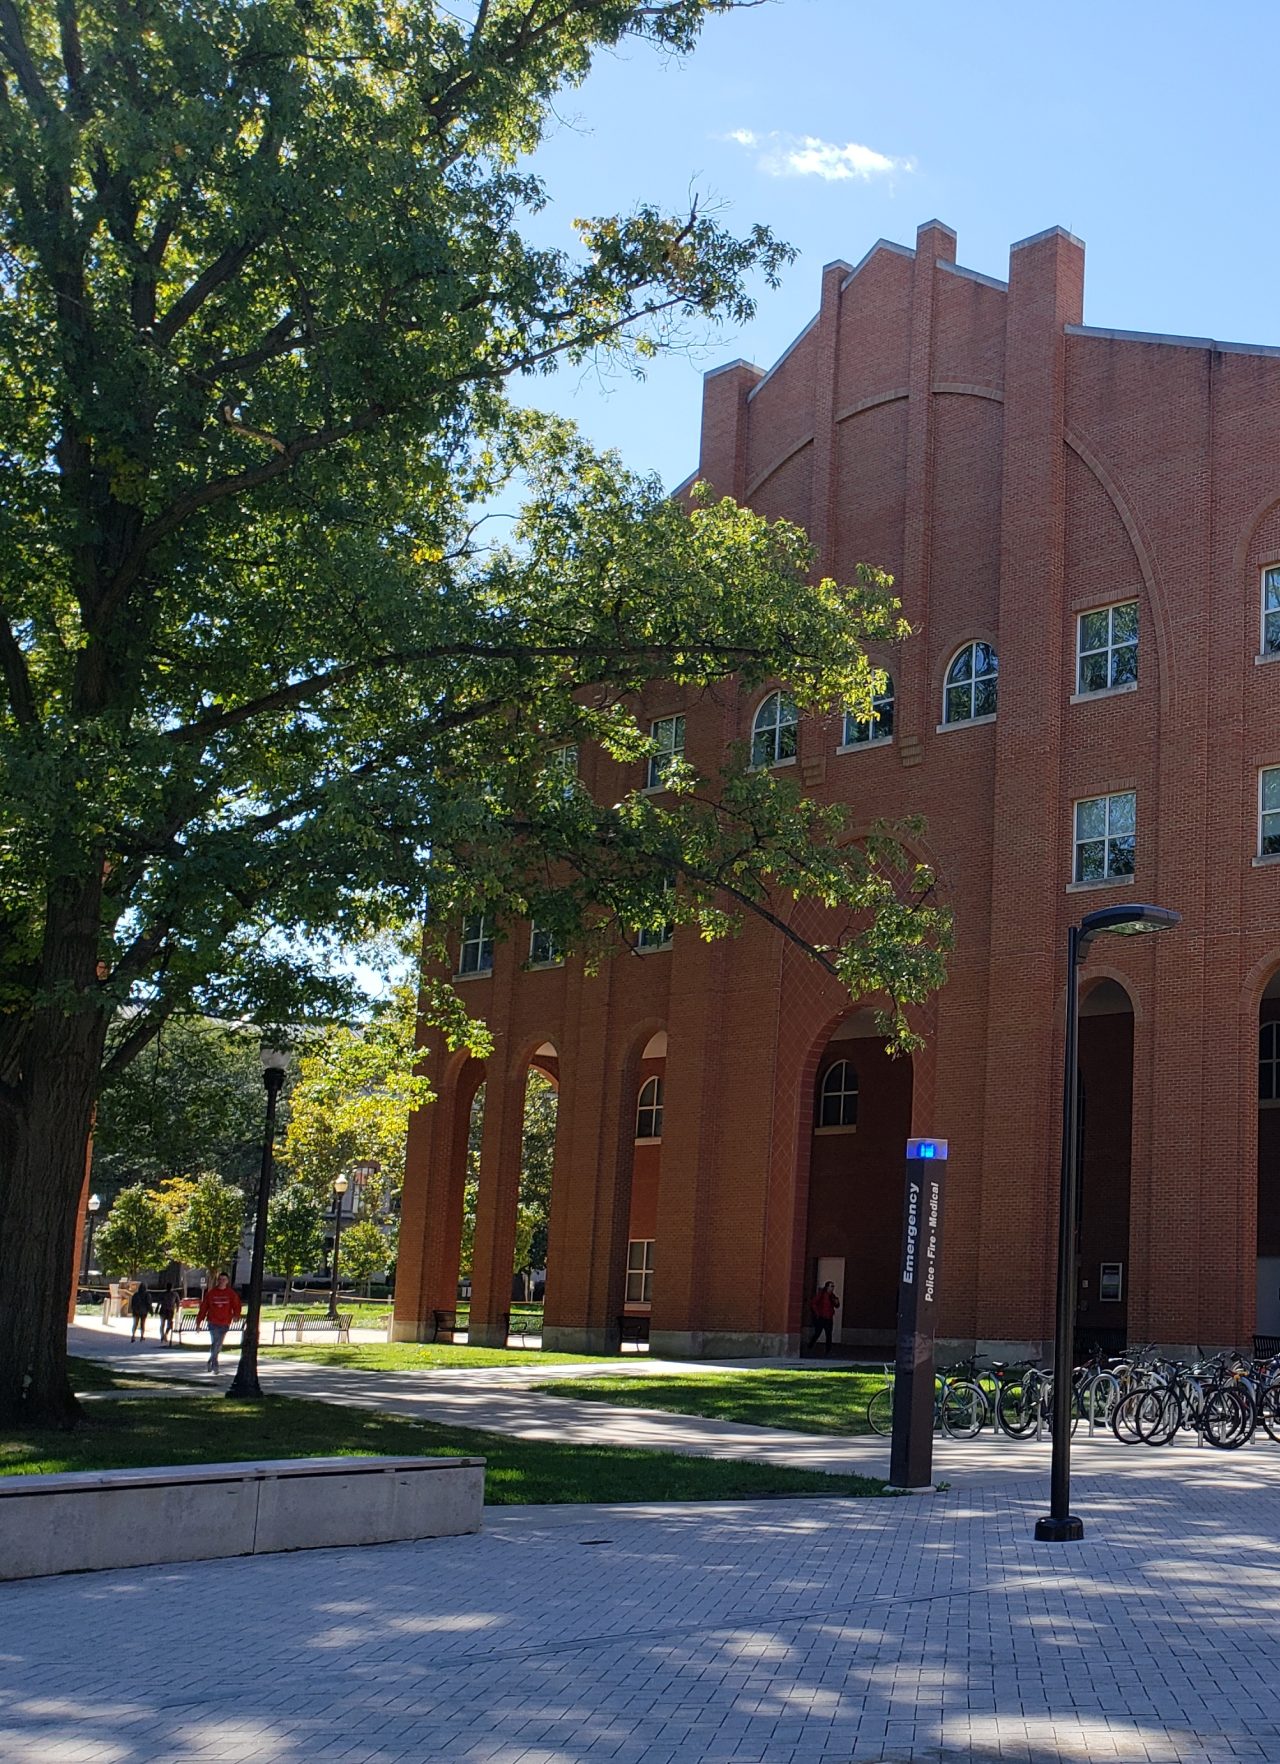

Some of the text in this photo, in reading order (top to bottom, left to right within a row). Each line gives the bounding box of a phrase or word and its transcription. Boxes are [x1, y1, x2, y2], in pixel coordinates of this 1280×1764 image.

[903, 1182, 920, 1284] Emergency
[925, 1181, 939, 1302] Police Fire Medical
